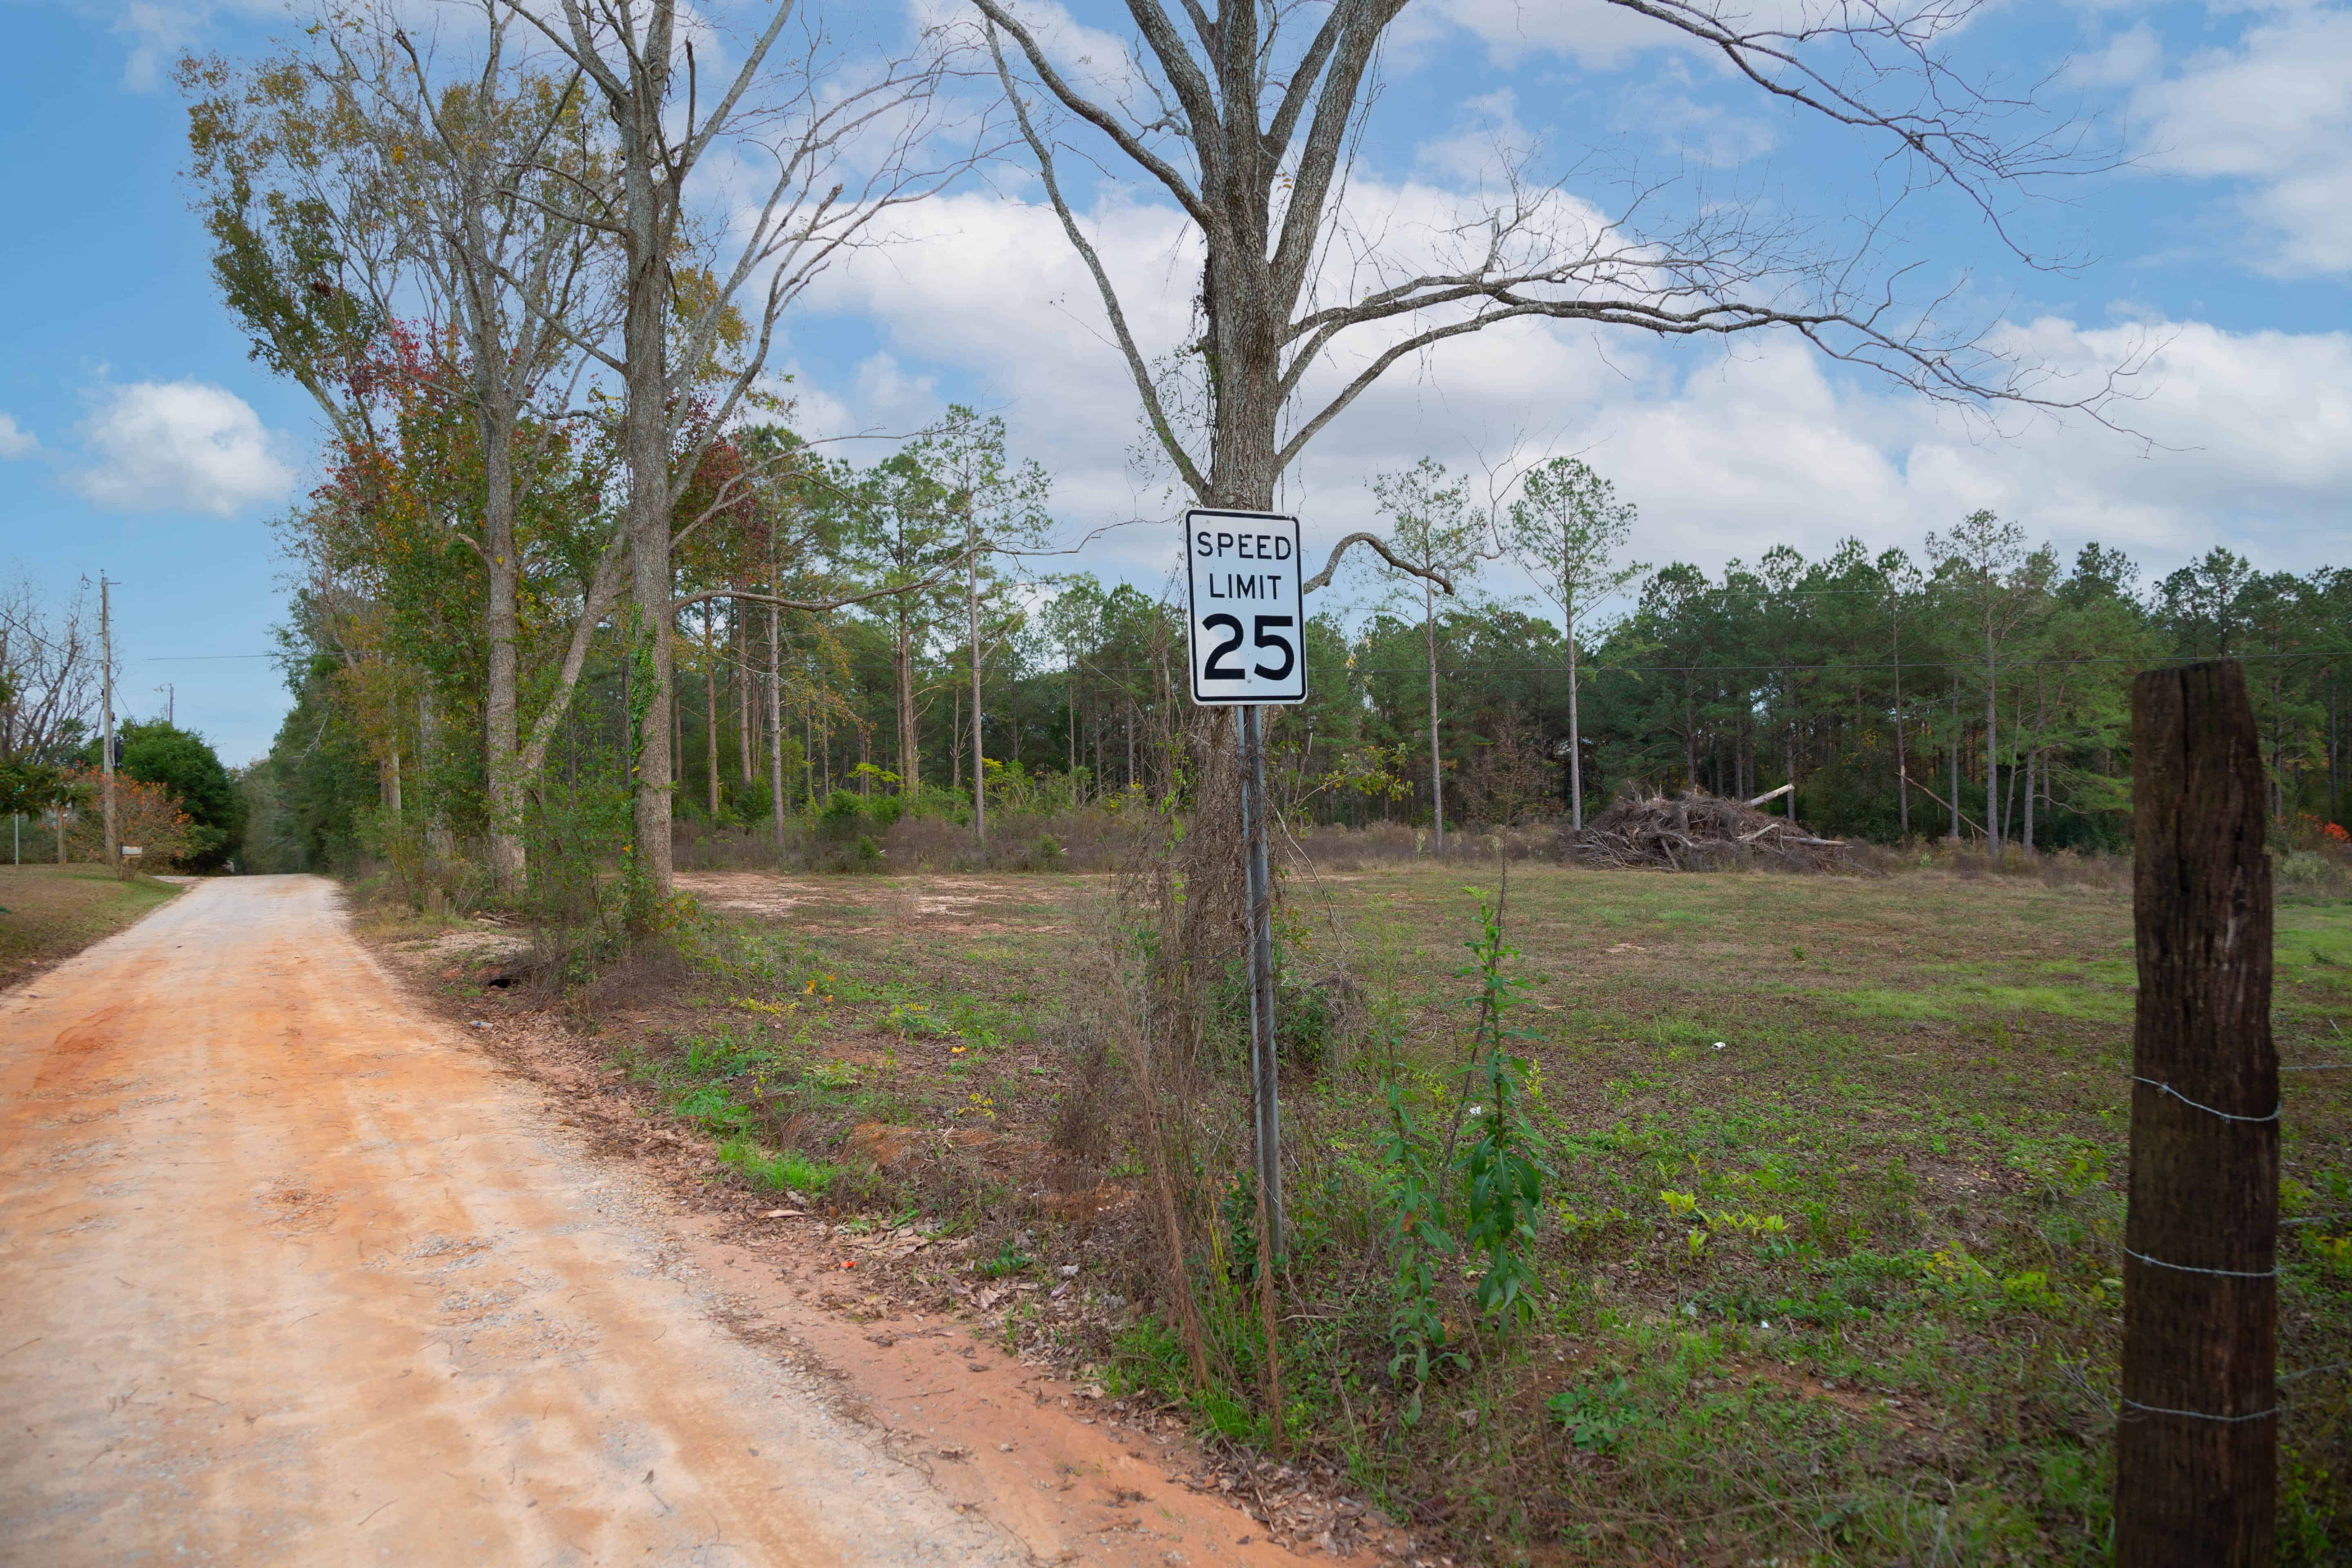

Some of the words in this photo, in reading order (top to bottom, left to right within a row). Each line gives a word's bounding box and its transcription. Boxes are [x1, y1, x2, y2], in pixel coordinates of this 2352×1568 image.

[1197, 531, 1291, 560] SPEED
[1209, 573, 1281, 600] LIMIT
[1202, 613, 1294, 681] 25
